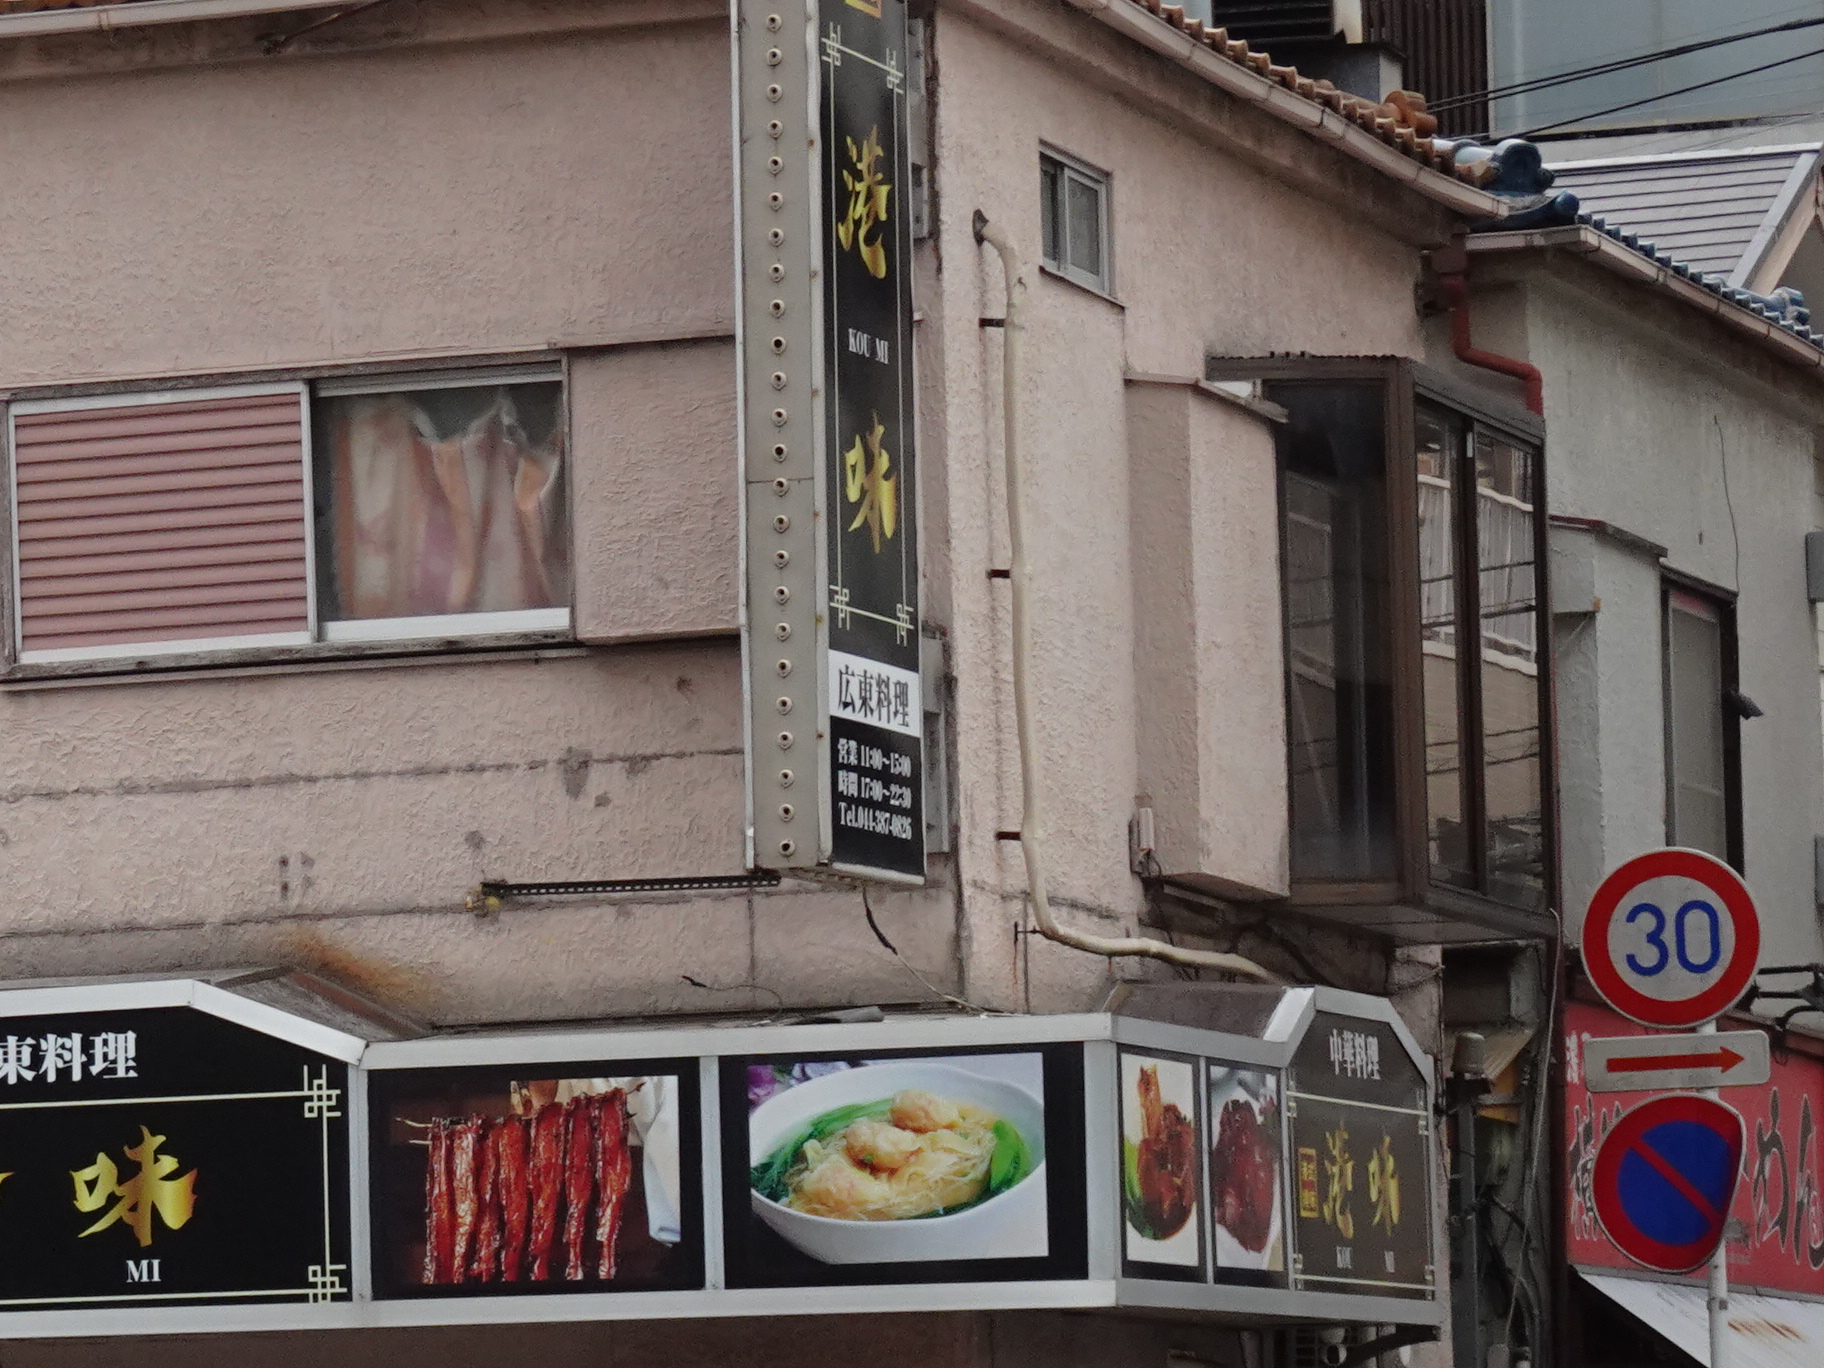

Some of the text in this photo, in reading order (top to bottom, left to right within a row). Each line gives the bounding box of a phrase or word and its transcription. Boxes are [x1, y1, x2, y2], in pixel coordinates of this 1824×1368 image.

[848, 326, 889, 365] KOU MI
[837, 663, 910, 728] 広東料理
[837, 737, 858, 766] 営業
[837, 769, 858, 799] 時間
[1625, 902, 1721, 976] 30
[1329, 1028, 1381, 1081] 中華料理
[126, 1259, 161, 1285] MI
